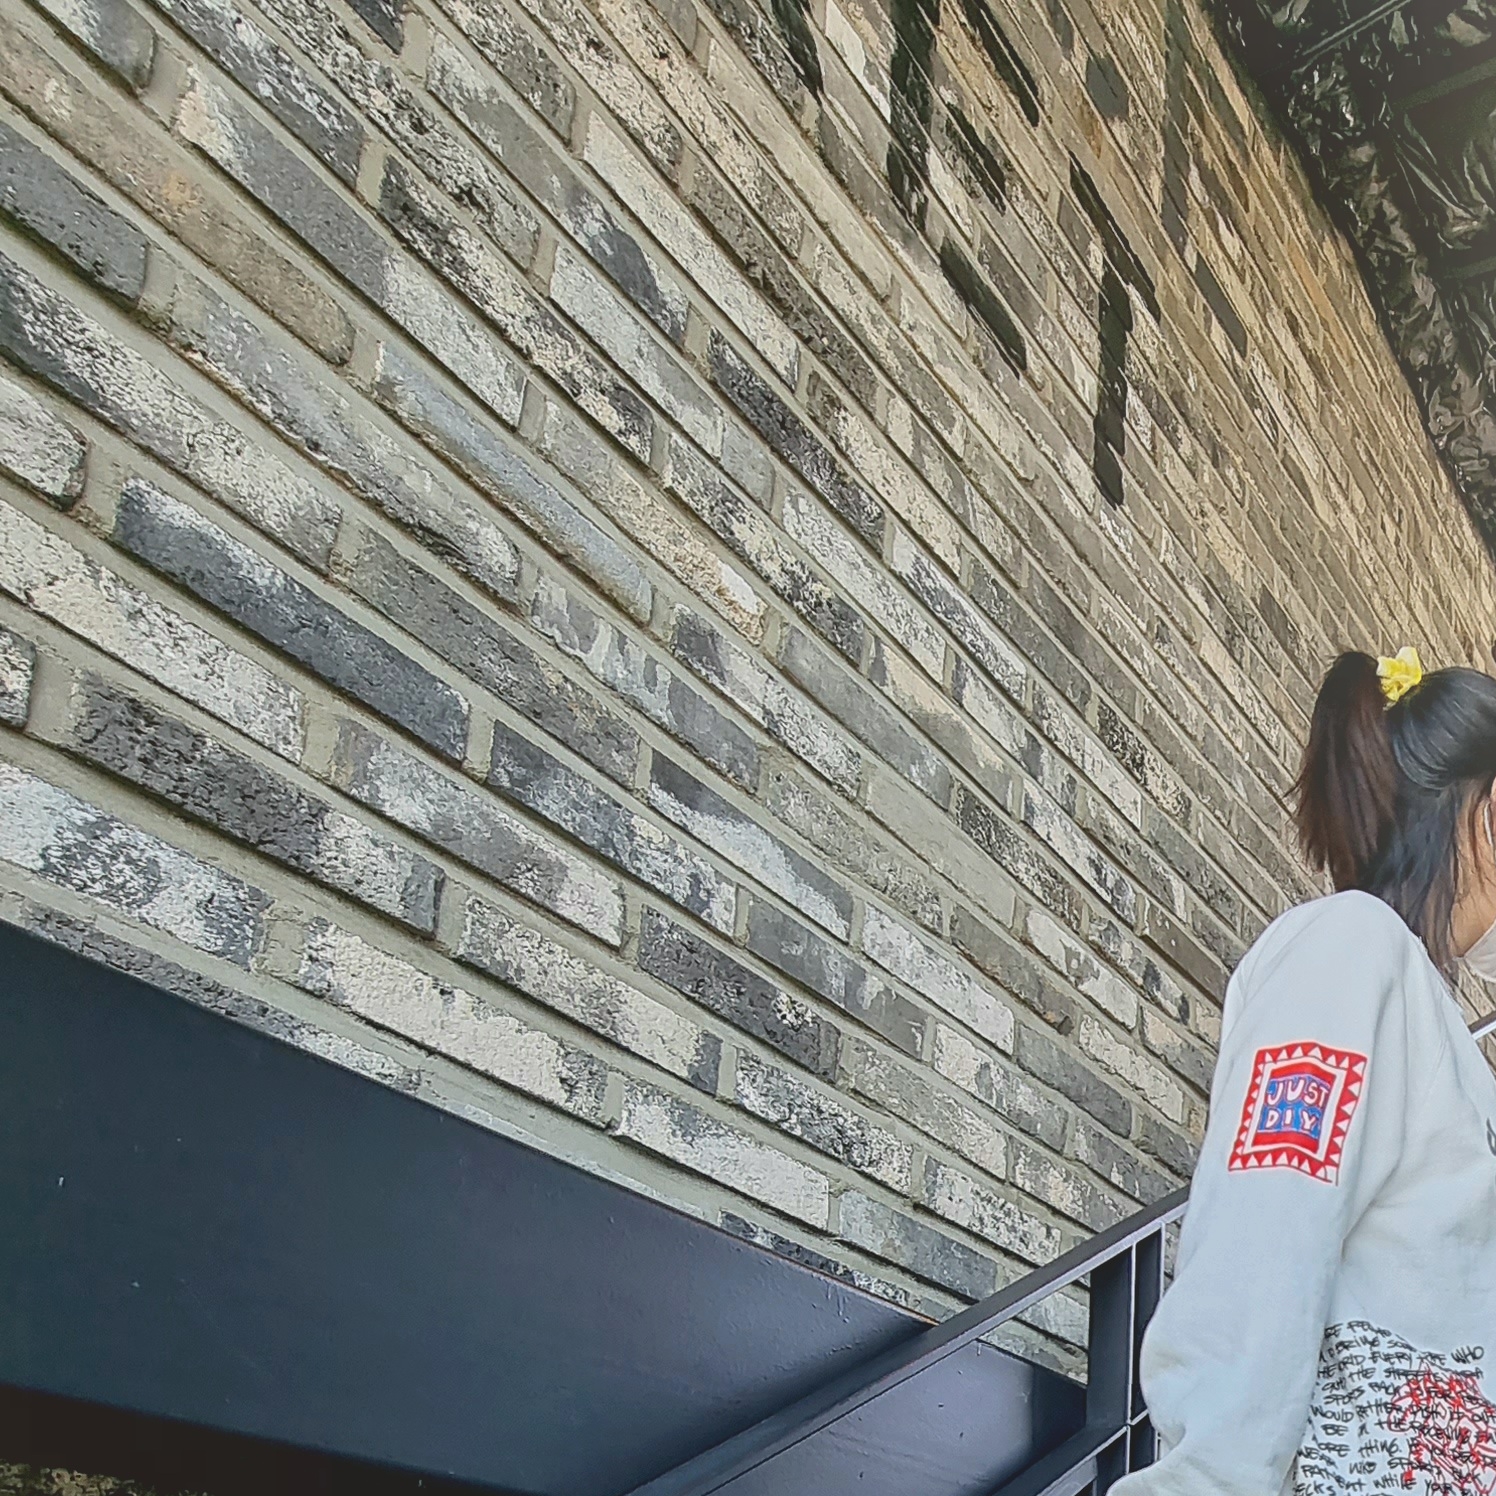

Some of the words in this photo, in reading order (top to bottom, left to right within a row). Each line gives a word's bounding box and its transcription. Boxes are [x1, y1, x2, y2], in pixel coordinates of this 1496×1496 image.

[1266, 1079, 1329, 1107] JUST
[1265, 1109, 1317, 1131] DIY
[1451, 1346, 1484, 1364] WHO
[1310, 1404, 1354, 1423] WOULD
